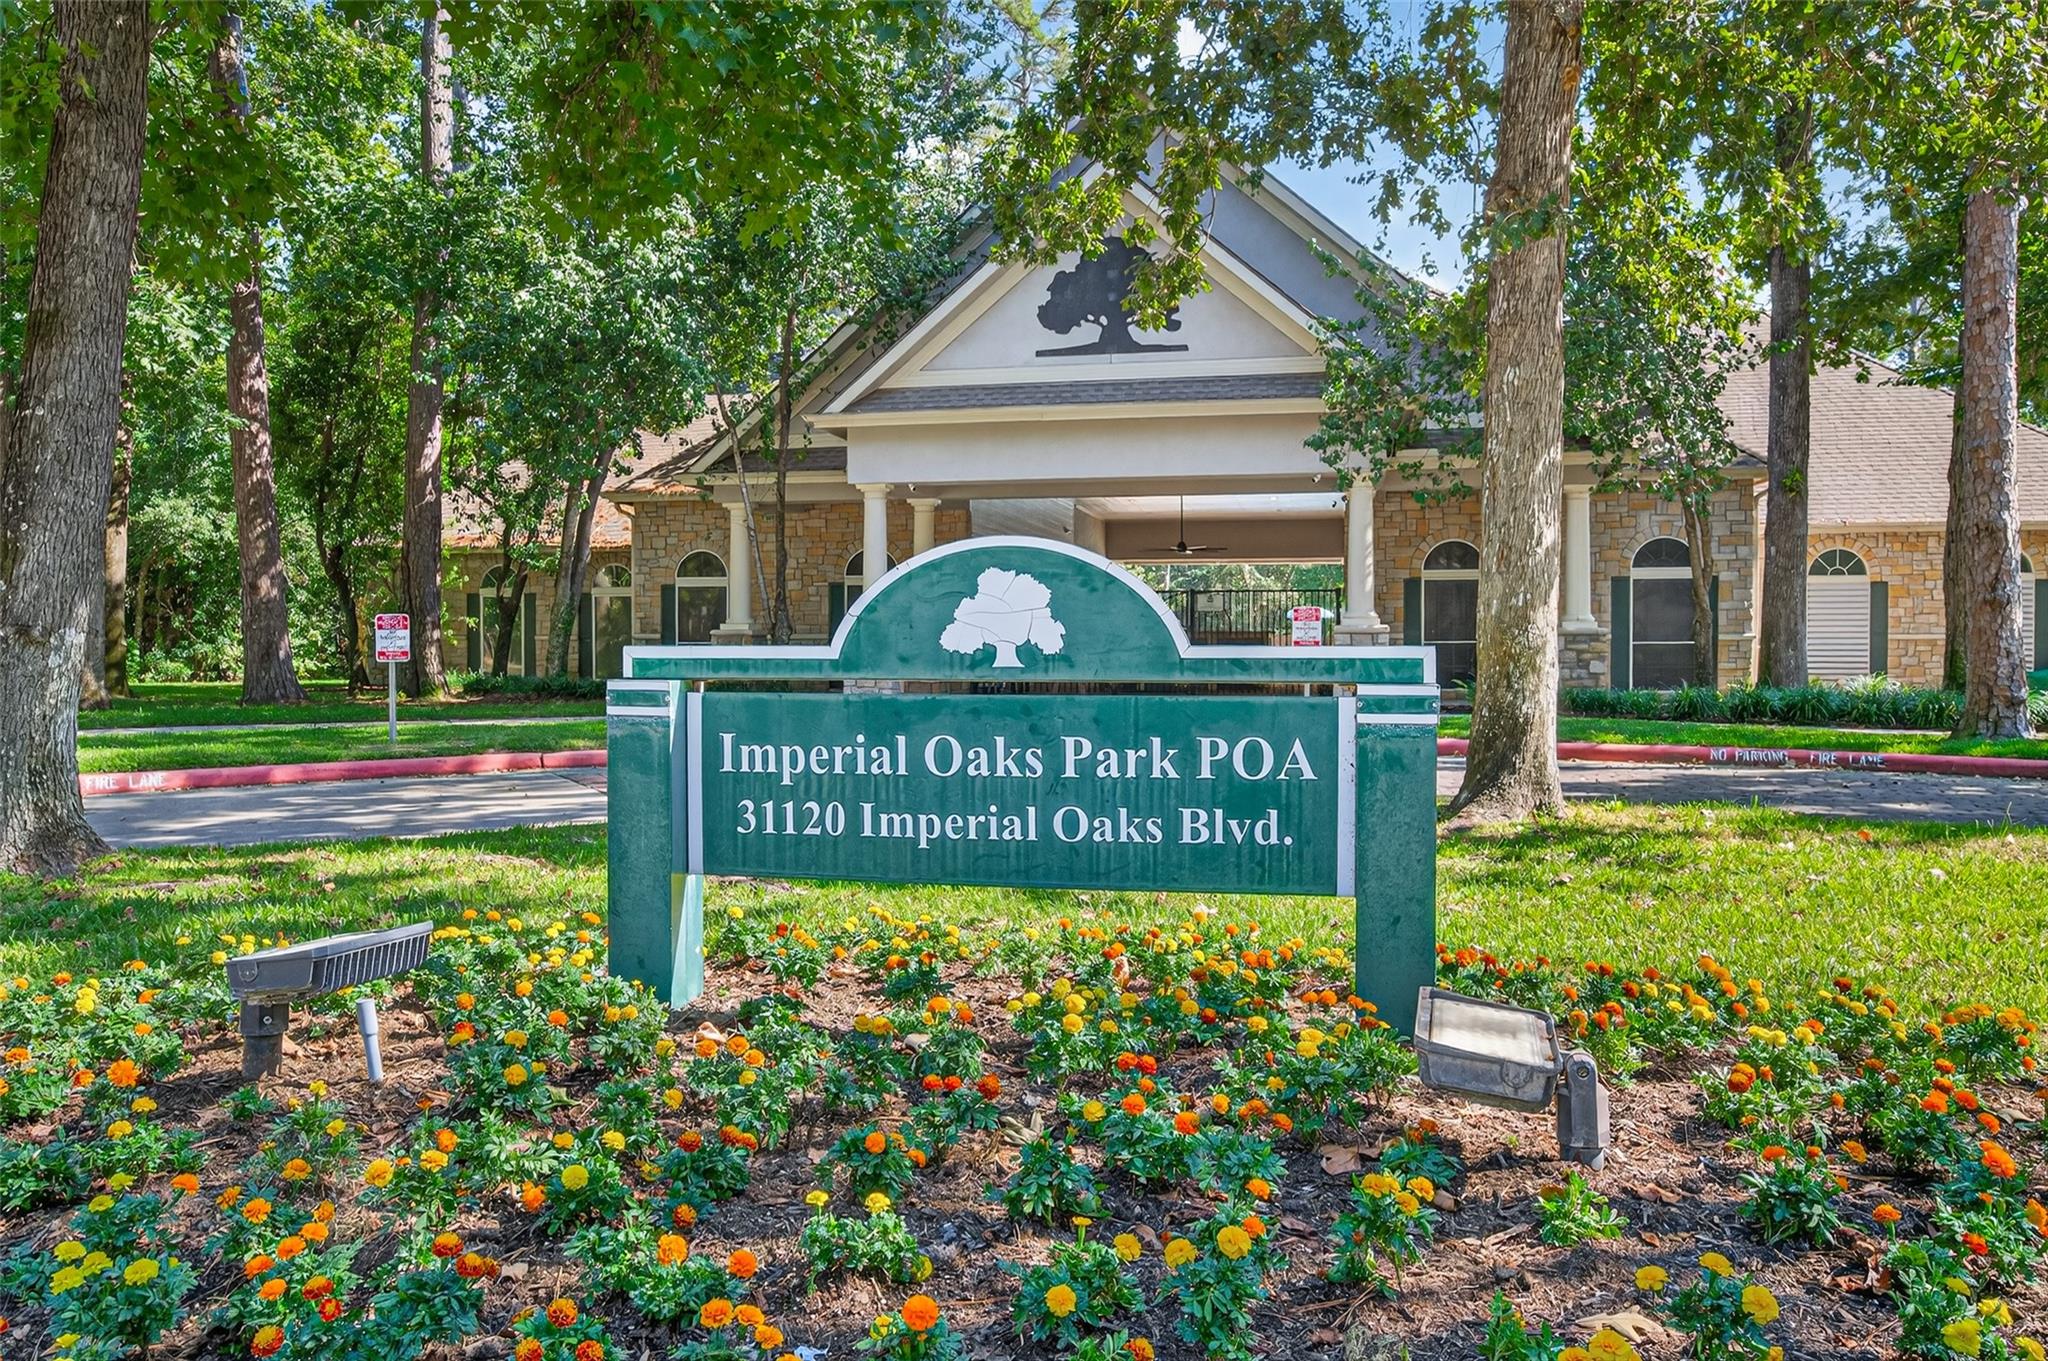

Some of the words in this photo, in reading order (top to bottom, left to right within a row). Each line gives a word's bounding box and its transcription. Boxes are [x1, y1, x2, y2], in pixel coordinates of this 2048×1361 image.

[718, 732, 909, 786] Imperial
[924, 734, 1044, 778] Oaks
[1060, 735, 1181, 779] Park
[1195, 736, 1318, 780] POA
[1710, 748, 1727, 760] NO
[1810, 752, 1838, 765] FIRE
[85, 776, 119, 790] FIRE
[128, 772, 167, 789] LANE
[735, 799, 846, 836] 31120
[859, 802, 1039, 849] Imperial
[1052, 806, 1163, 844] Oaks
[1178, 807, 1294, 846] Blvd.
